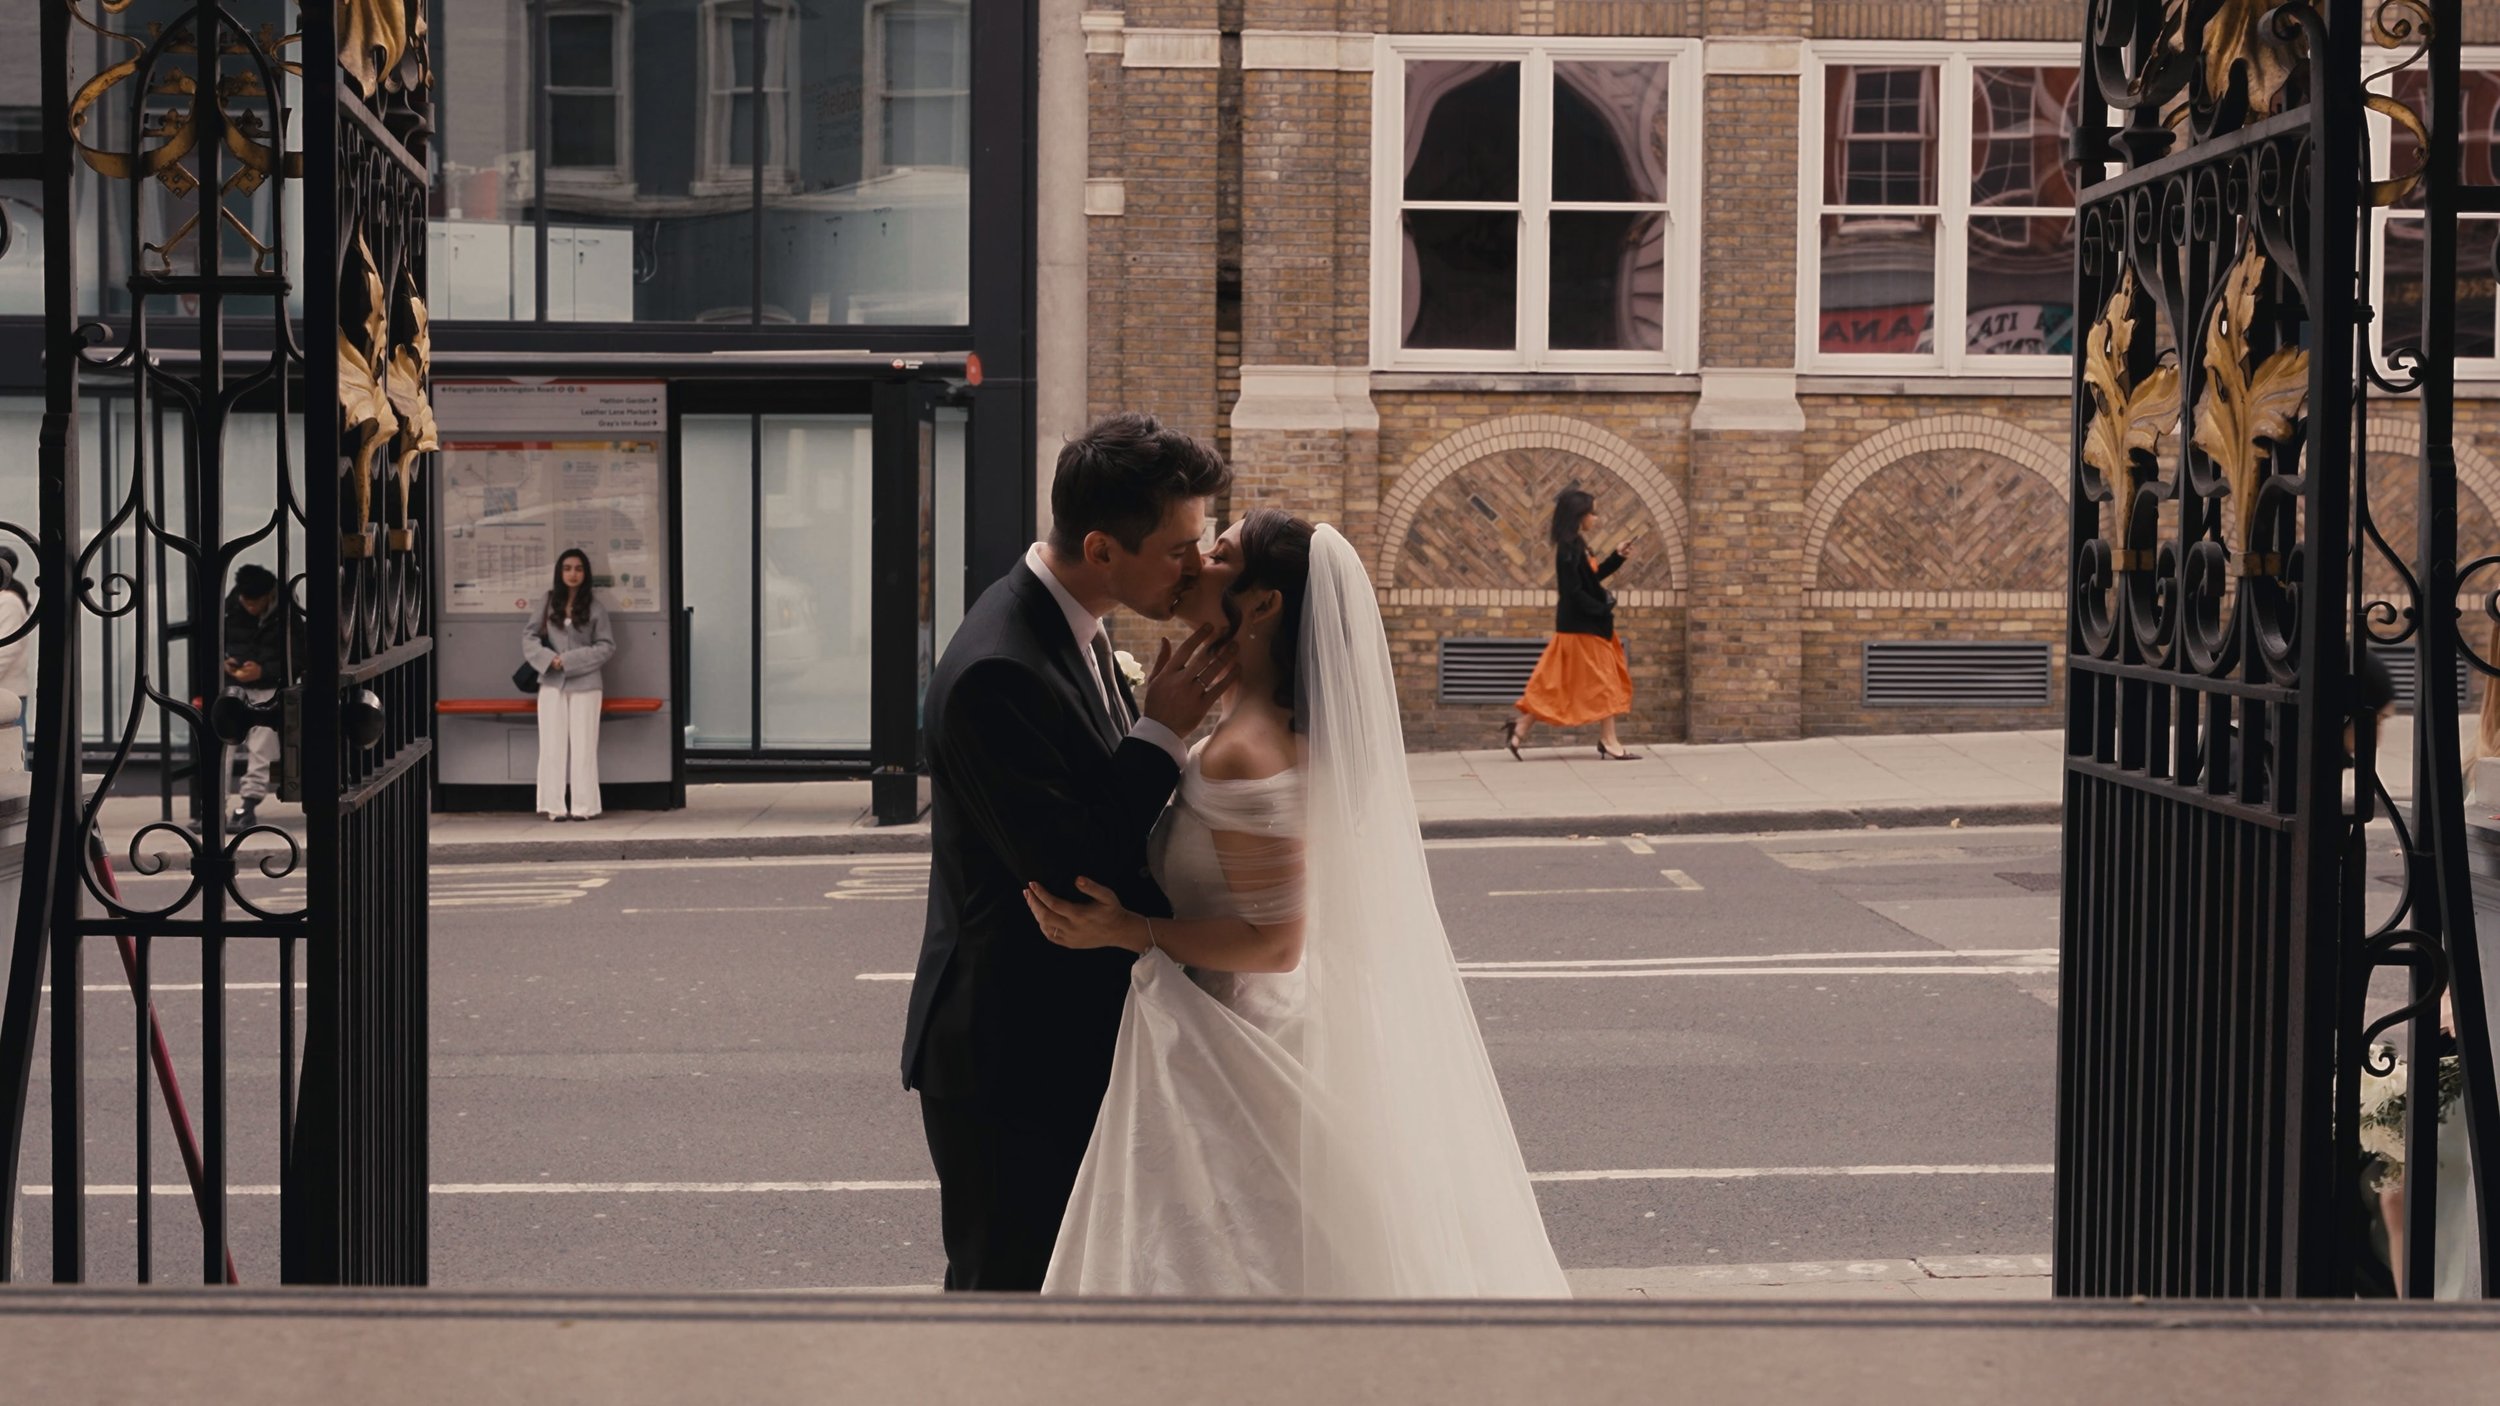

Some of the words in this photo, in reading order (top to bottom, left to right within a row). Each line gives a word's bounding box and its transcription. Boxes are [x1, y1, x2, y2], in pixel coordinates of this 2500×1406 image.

[448, 385, 484, 394] Farringdon
[499, 385, 535, 394] Farringdon
[600, 396, 624, 404] Hatton
[625, 396, 650, 404] Garden
[580, 408, 607, 416] Leather
[608, 408, 625, 416] Lane
[626, 408, 650, 416] Market
[598, 420, 619, 429] Gray's
